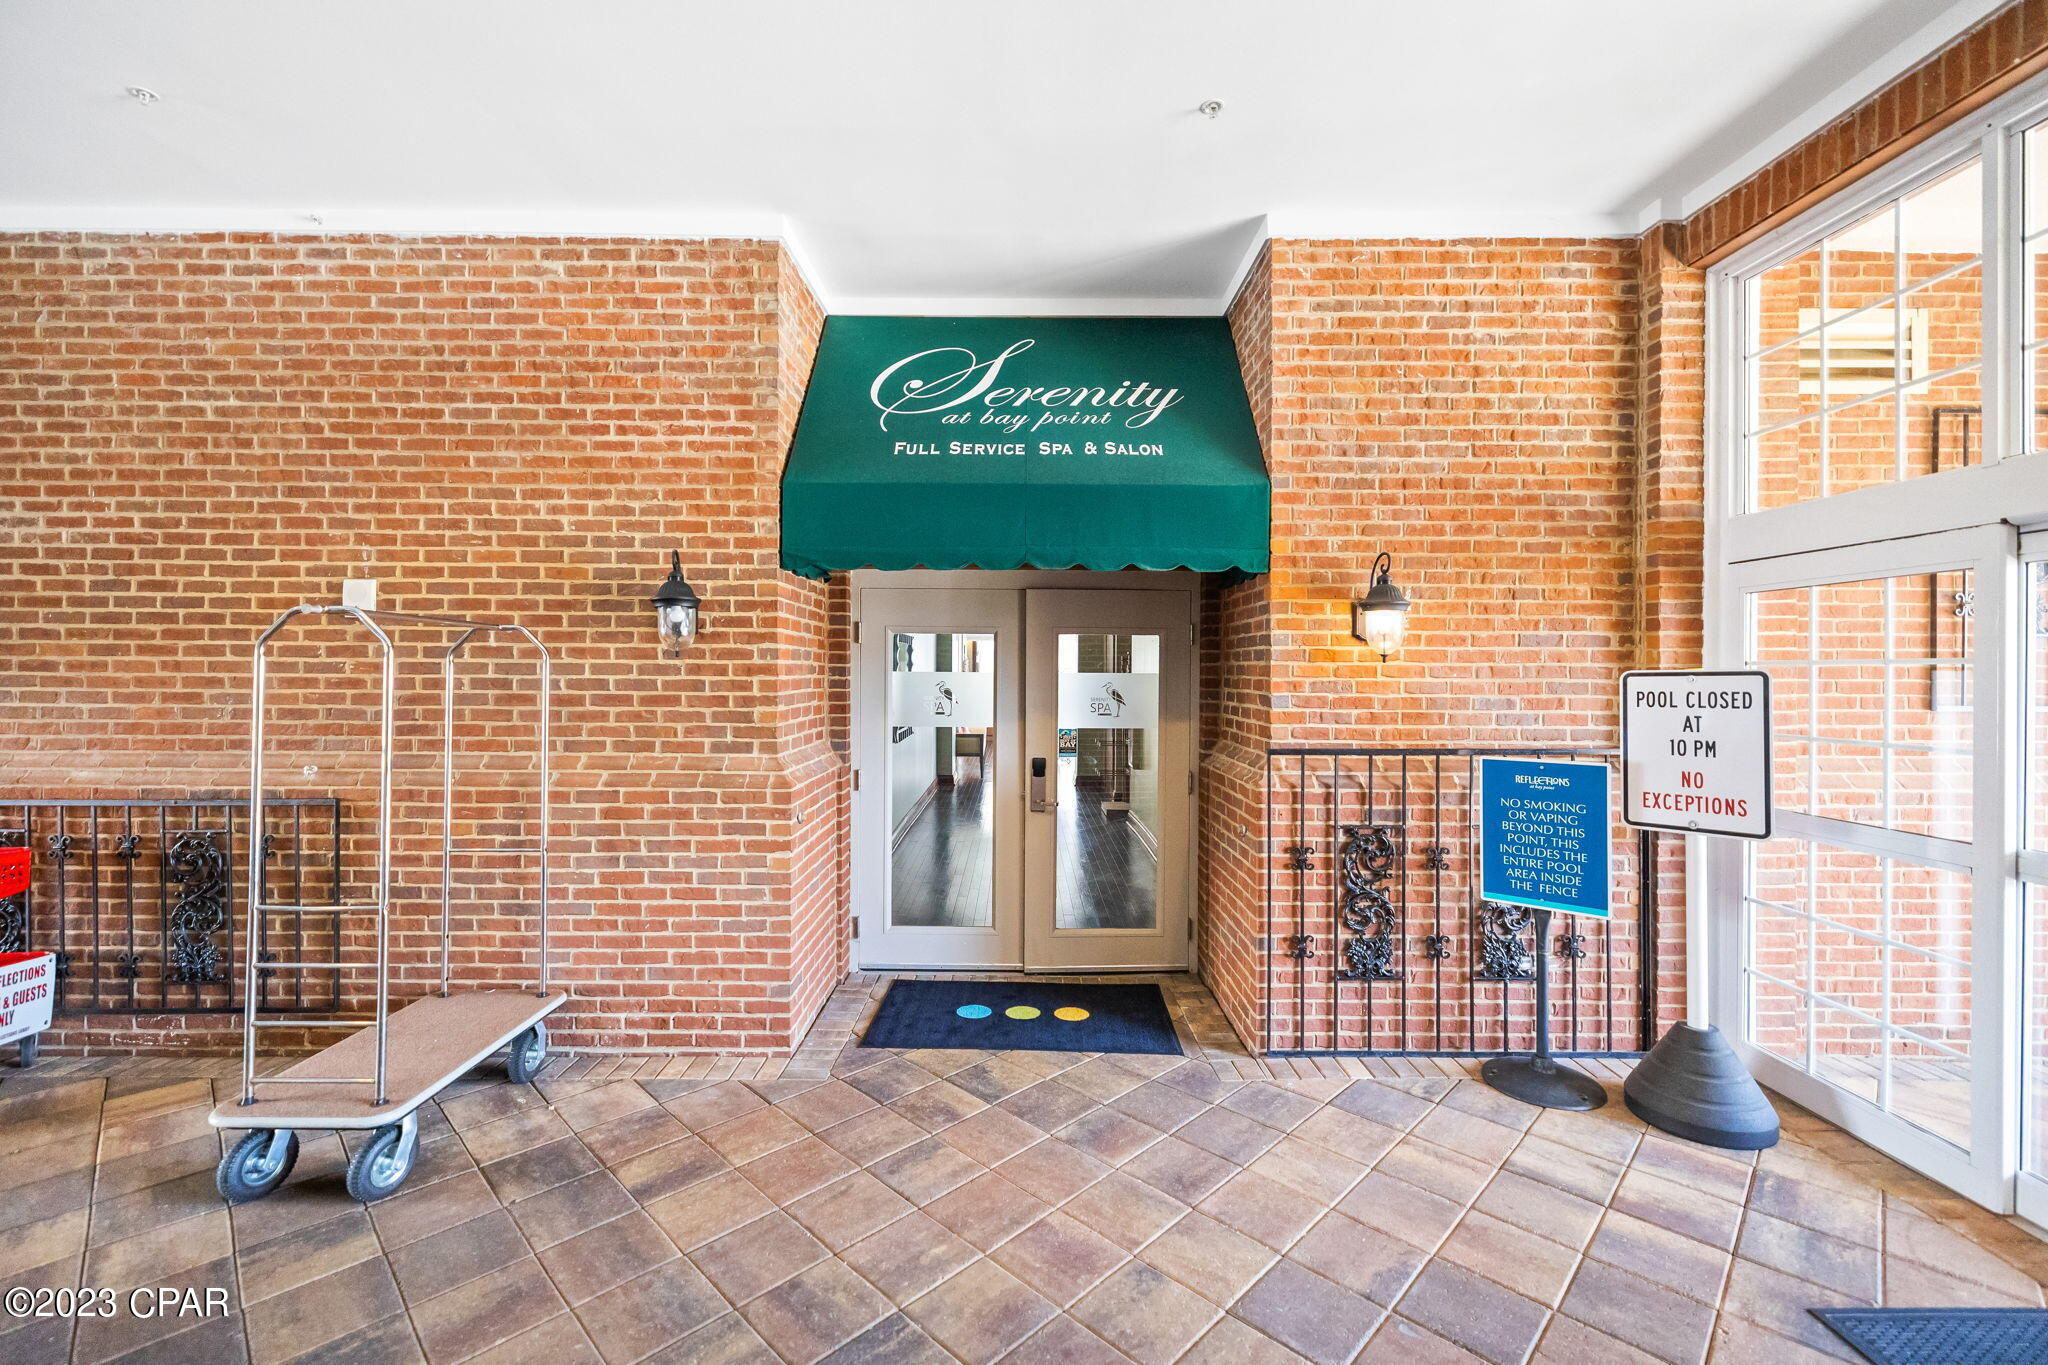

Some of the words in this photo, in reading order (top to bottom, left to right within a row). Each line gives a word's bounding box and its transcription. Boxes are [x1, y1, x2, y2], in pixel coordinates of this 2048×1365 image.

[870, 339, 1184, 432] Serenity
[942, 410, 976, 425] at
[981, 408, 1030, 434] bay
[1030, 410, 1111, 433] point
[894, 441, 940, 456] FULL
[949, 441, 1026, 456] SERVICE
[1039, 441, 1074, 456] SPA
[1085, 441, 1098, 456] &
[1105, 441, 1165, 456] SALON
[1090, 702, 1112, 713] SPA
[1636, 691, 1678, 708] POOL
[1686, 691, 1753, 709] CLOSED
[1682, 715, 1702, 733] AT
[1669, 739, 1687, 757] 10
[1694, 740, 1717, 758] PM
[1515, 775, 1570, 787] REFLECTIONS
[1681, 771, 1704, 789] NO
[1500, 797, 1521, 808] NO
[1524, 799, 1587, 814] SMOKING
[1642, 791, 1748, 817] EXCEPTIONS
[1508, 809, 1527, 821] OR
[1530, 811, 1579, 826] VAPING
[1502, 820, 1554, 835] BEYOND
[1557, 826, 1586, 838] THIS
[1507, 833, 1548, 848] POINT,
[1551, 837, 1580, 850] THIS
[1500, 843, 1560, 860] INCLUDES
[1563, 851, 1588, 863] THE
[1503, 855, 1544, 869] ENTIRE
[1547, 860, 1585, 875] POOL
[1506, 867, 1538, 880] AREA
[1541, 872, 1582, 887] INSIDE
[1510, 879, 1533, 891] THE
[1539, 883, 1579, 898] FENCE
[3, 996, 9, 1009] &
[12, 983, 48, 1008] GUESTS
